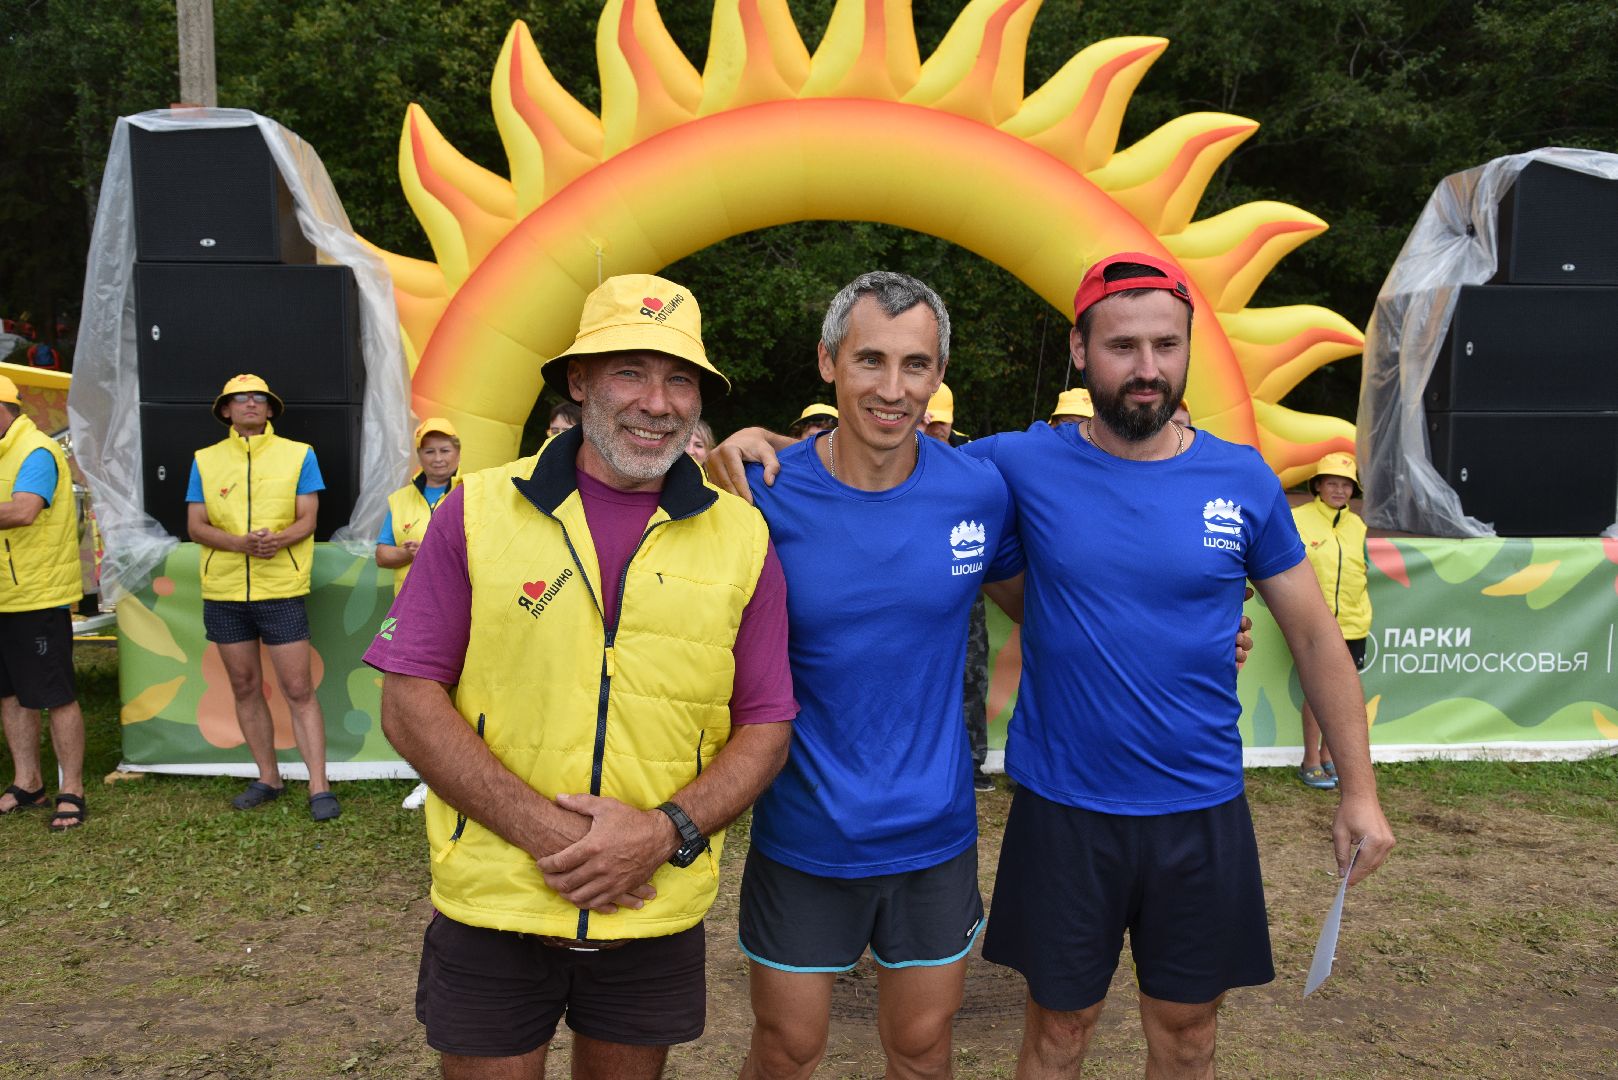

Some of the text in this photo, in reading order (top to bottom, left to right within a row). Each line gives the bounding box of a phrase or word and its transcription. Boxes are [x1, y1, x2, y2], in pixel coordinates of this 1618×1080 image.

[640, 307, 656, 318] Я
[1203, 536, 1241, 552] ШОША
[951, 561, 983, 576] ШОША
[530, 568, 573, 620] ЛОТОШИНО
[518, 595, 534, 611] Я
[1384, 627, 1472, 648] ПАРКИ
[1382, 652, 1589, 674] ПОДМОСКОВЬЯ
